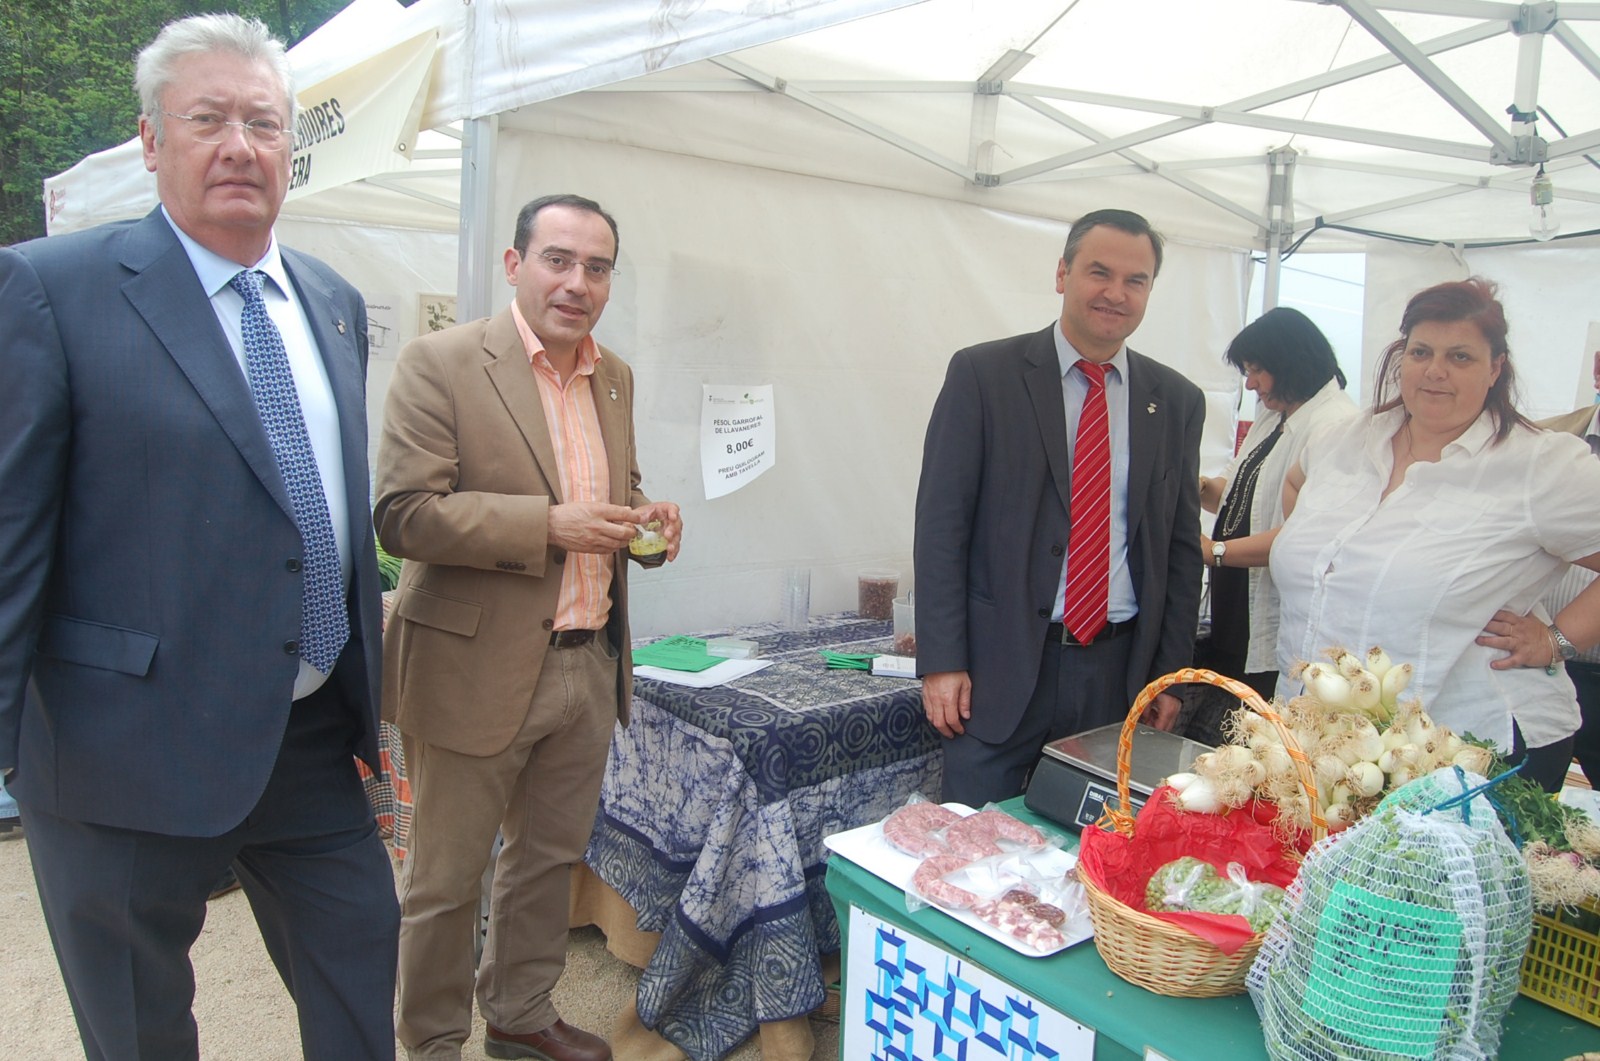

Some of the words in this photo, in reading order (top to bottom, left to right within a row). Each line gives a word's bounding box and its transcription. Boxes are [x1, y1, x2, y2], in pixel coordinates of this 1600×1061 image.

[732, 414, 763, 425] GARROFAL
[724, 421, 761, 434] LLAVANERES
[726, 438, 754, 455] 8,00€
[718, 465, 734, 474] PREU
[725, 471, 738, 479] AMB
